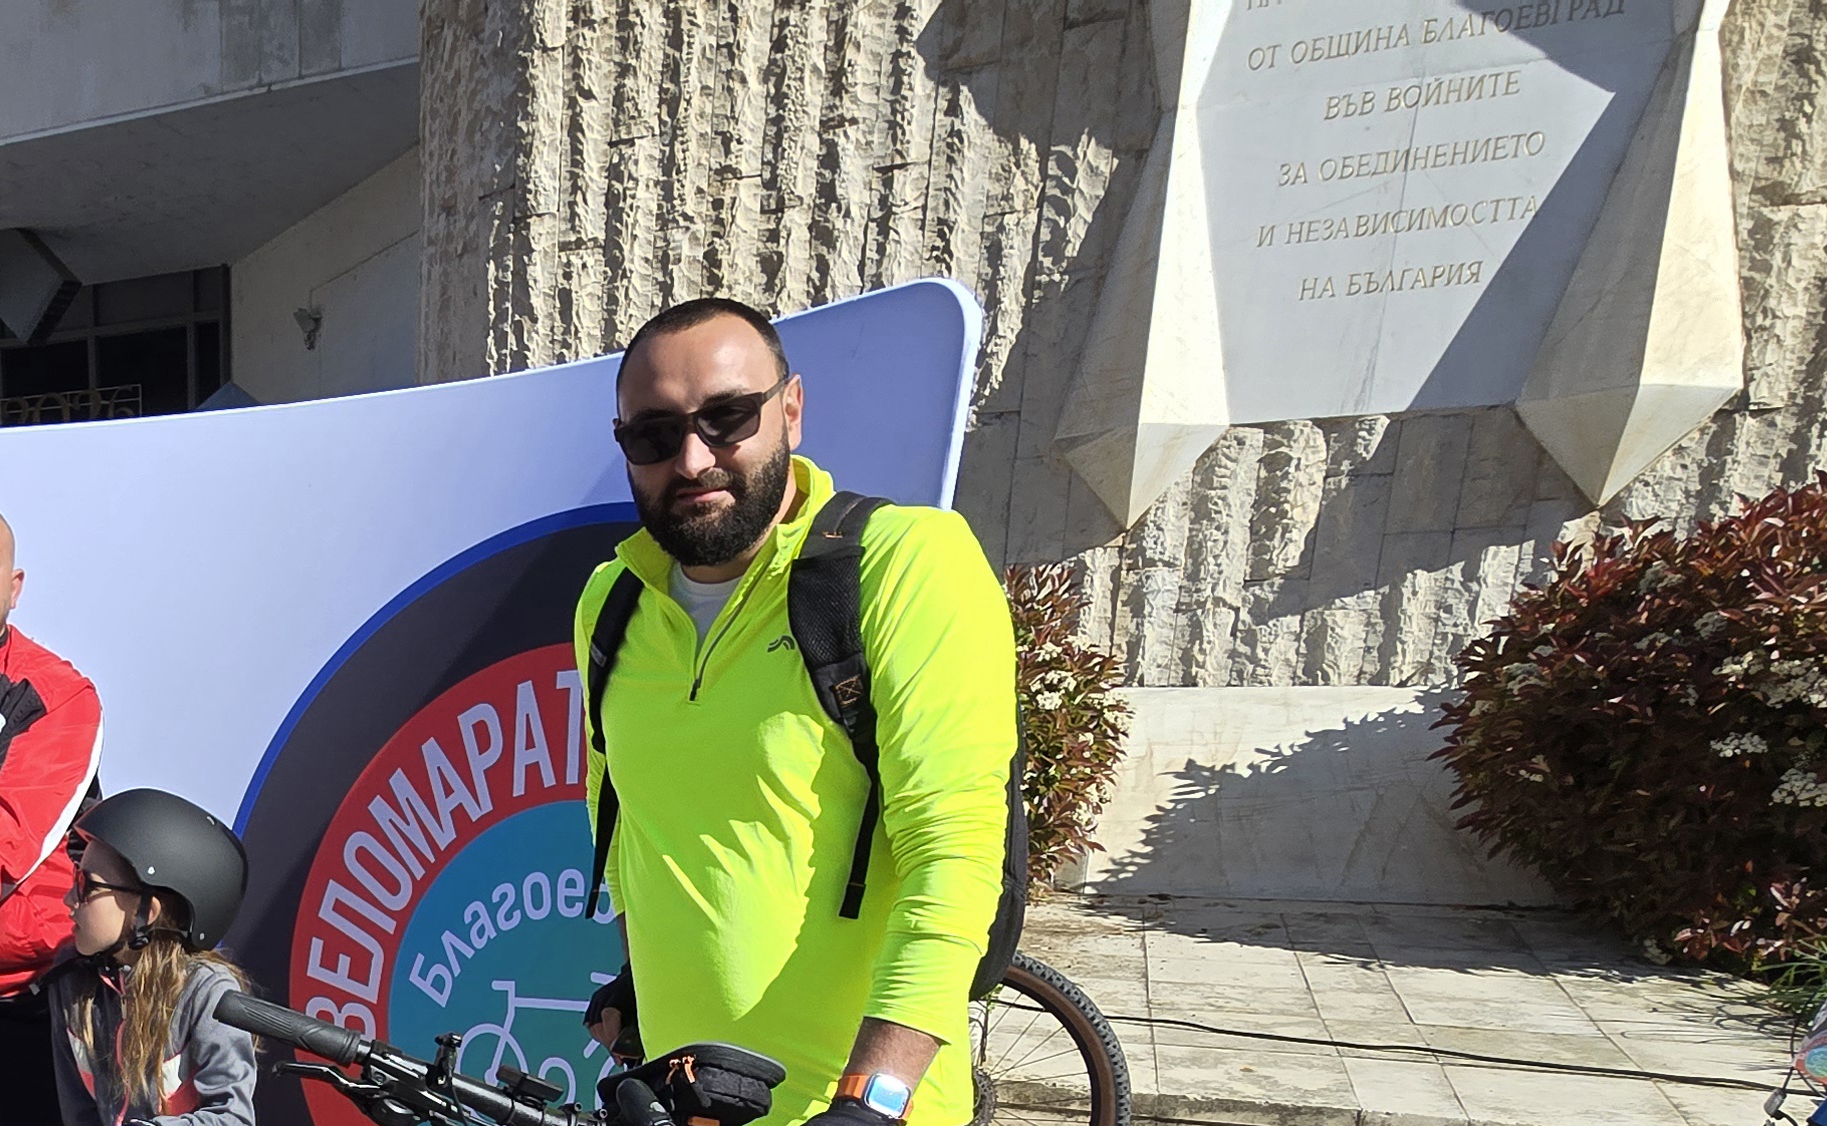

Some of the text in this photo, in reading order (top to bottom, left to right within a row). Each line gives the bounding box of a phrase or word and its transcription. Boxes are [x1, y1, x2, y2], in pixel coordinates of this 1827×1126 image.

[1247, 0, 1626, 71] ОТ ОБЩИНА БЛАГОЕВГРАД
[1323, 69, 1522, 121] ВЪВ ВОЙНИТЕ
[1277, 130, 1546, 187] ЗА ОБЕДИНЕНИЕТО
[1256, 194, 1539, 248] И НЕЗАВИСИМОСТТА
[1298, 260, 1484, 301] НА БЪЛГАРИЯ
[305, 669, 584, 1041] ВЕЛОМАРАТ
